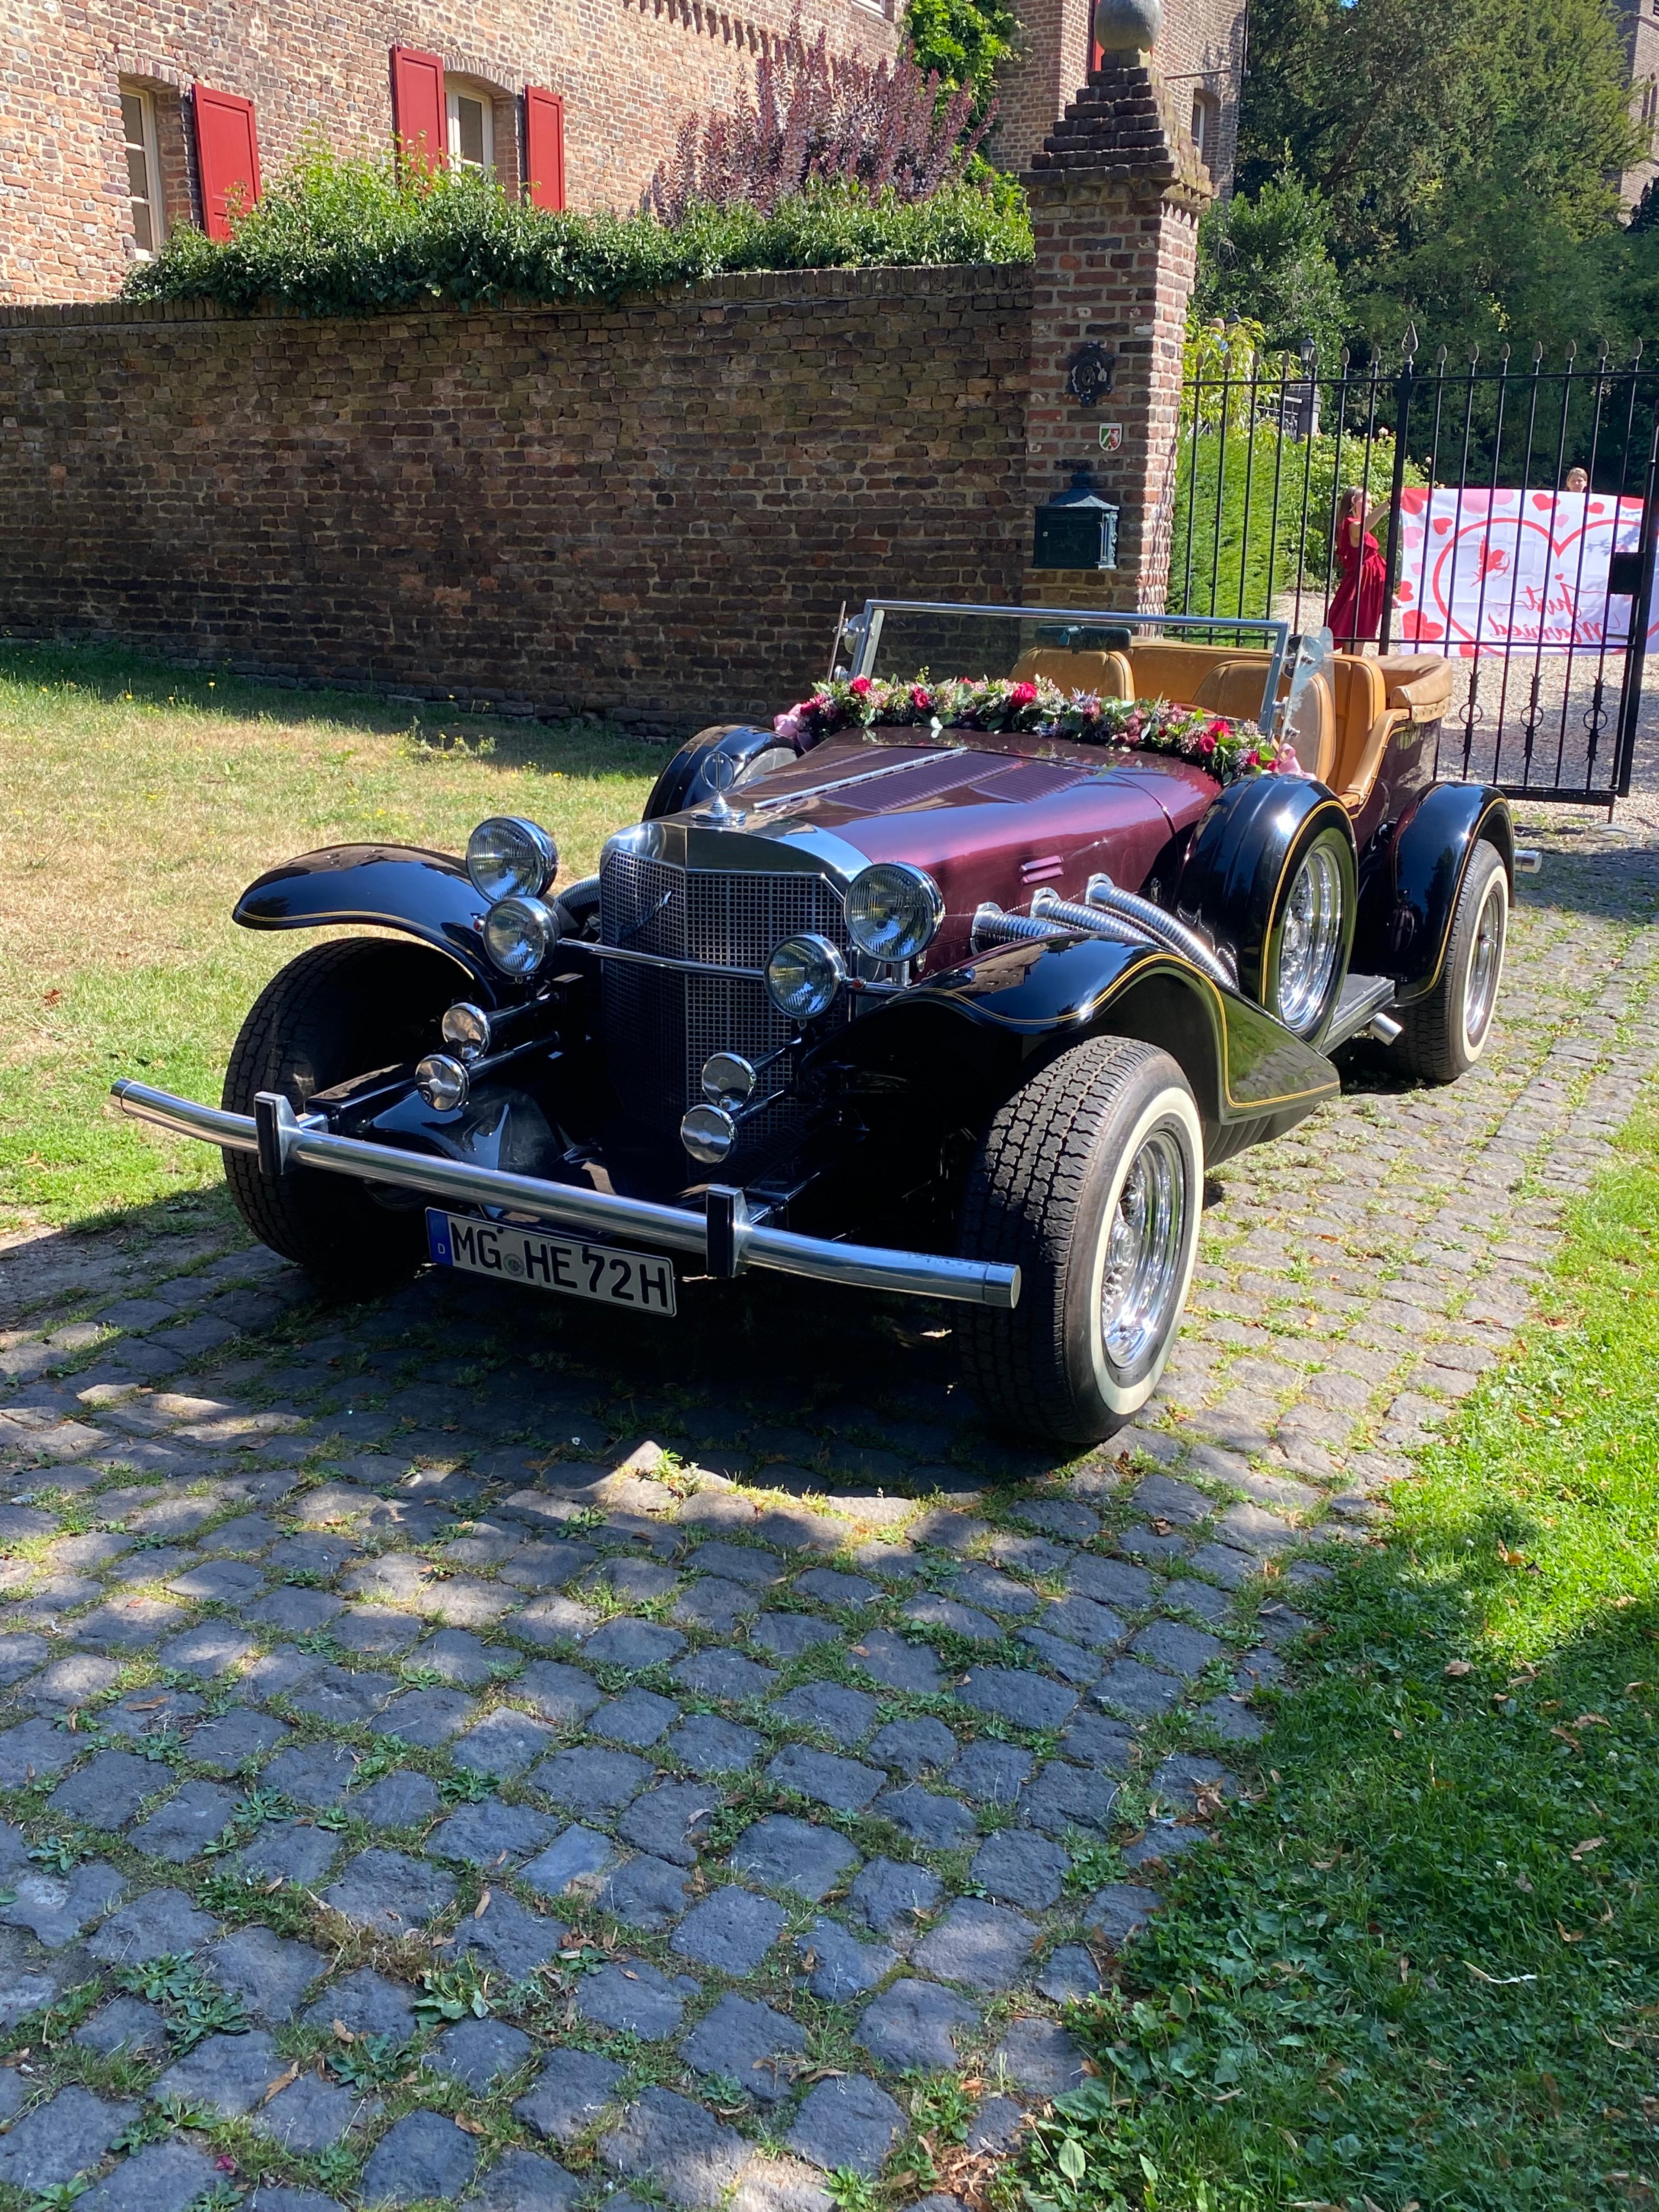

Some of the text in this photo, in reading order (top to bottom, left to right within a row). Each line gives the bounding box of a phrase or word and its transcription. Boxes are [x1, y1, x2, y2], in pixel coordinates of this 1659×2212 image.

[1082, 365, 1096, 386] 6
[437, 1243, 445, 1254] D
[450, 1222, 502, 1271] MG
